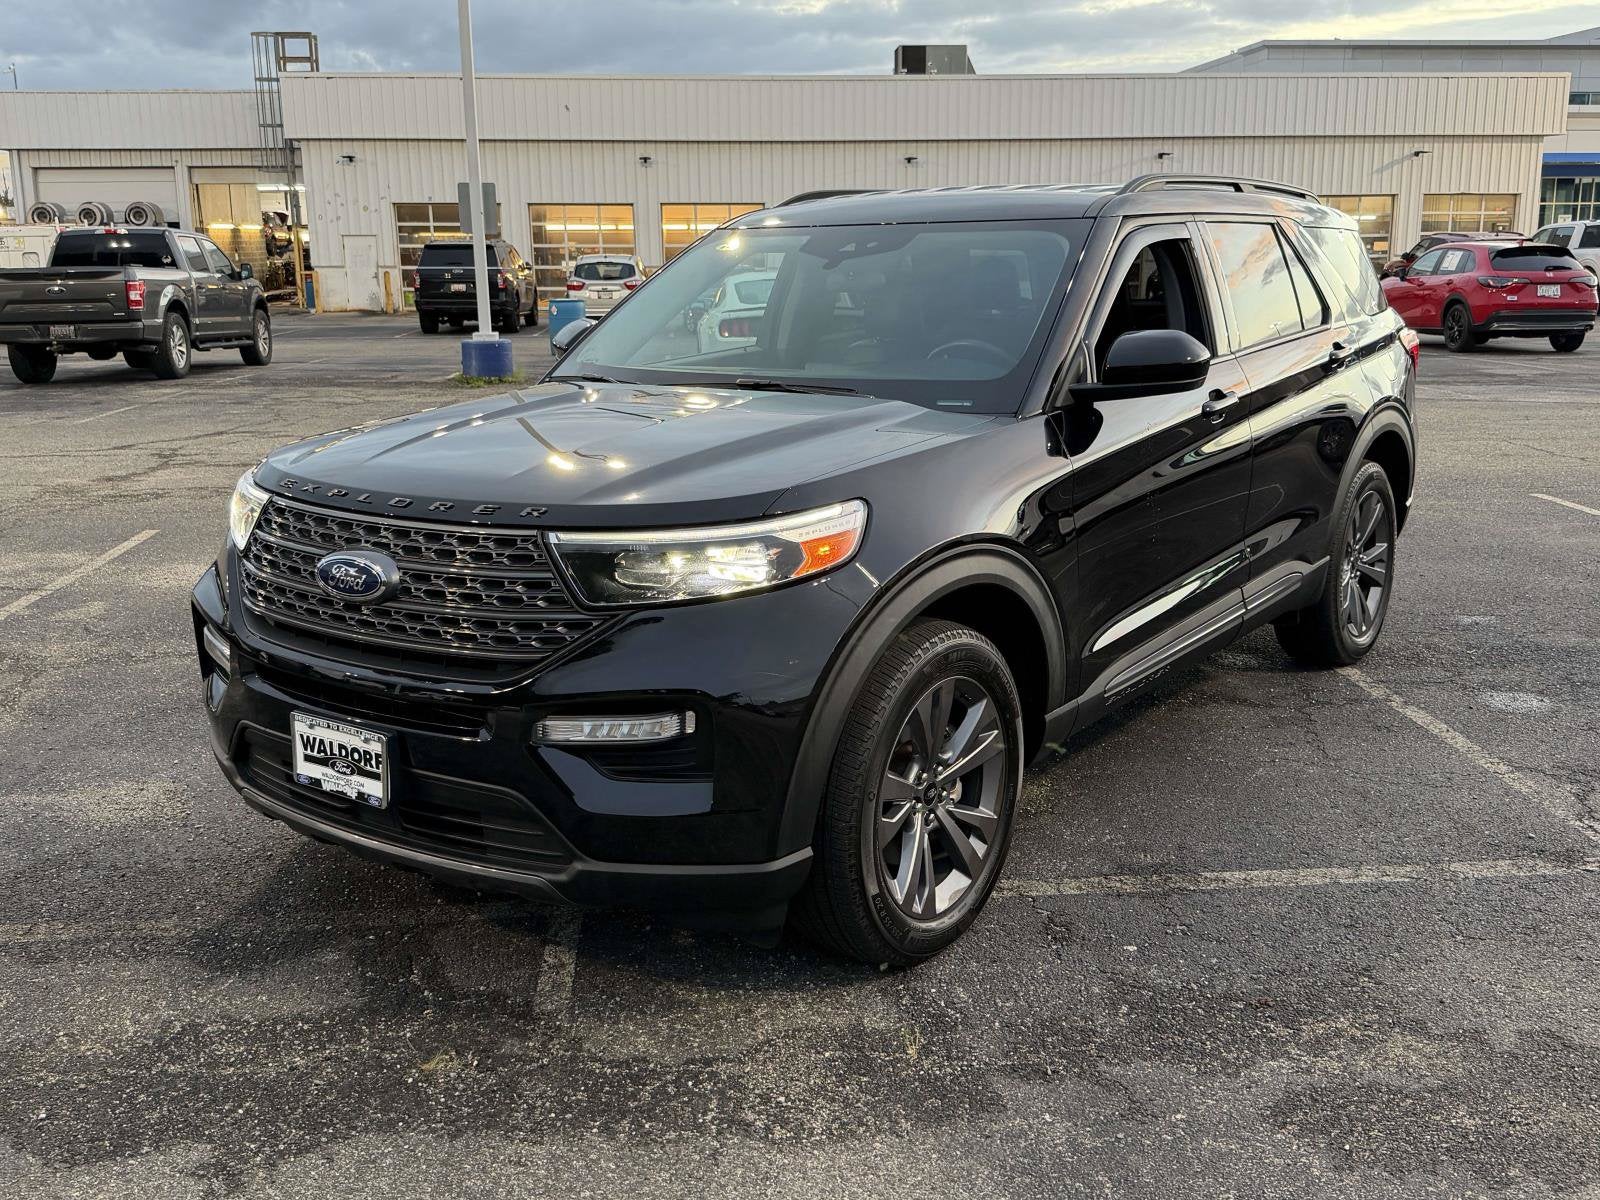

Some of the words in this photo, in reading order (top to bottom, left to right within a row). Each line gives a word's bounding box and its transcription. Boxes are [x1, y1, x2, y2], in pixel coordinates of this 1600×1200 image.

[279, 478, 549, 518] EXPLORER
[328, 564, 367, 591] Ford
[294, 714, 328, 728] DEDICATED
[340, 725, 379, 741] EXCELLENCE
[299, 733, 382, 771] WALDORF
[334, 762, 351, 775] Ford
